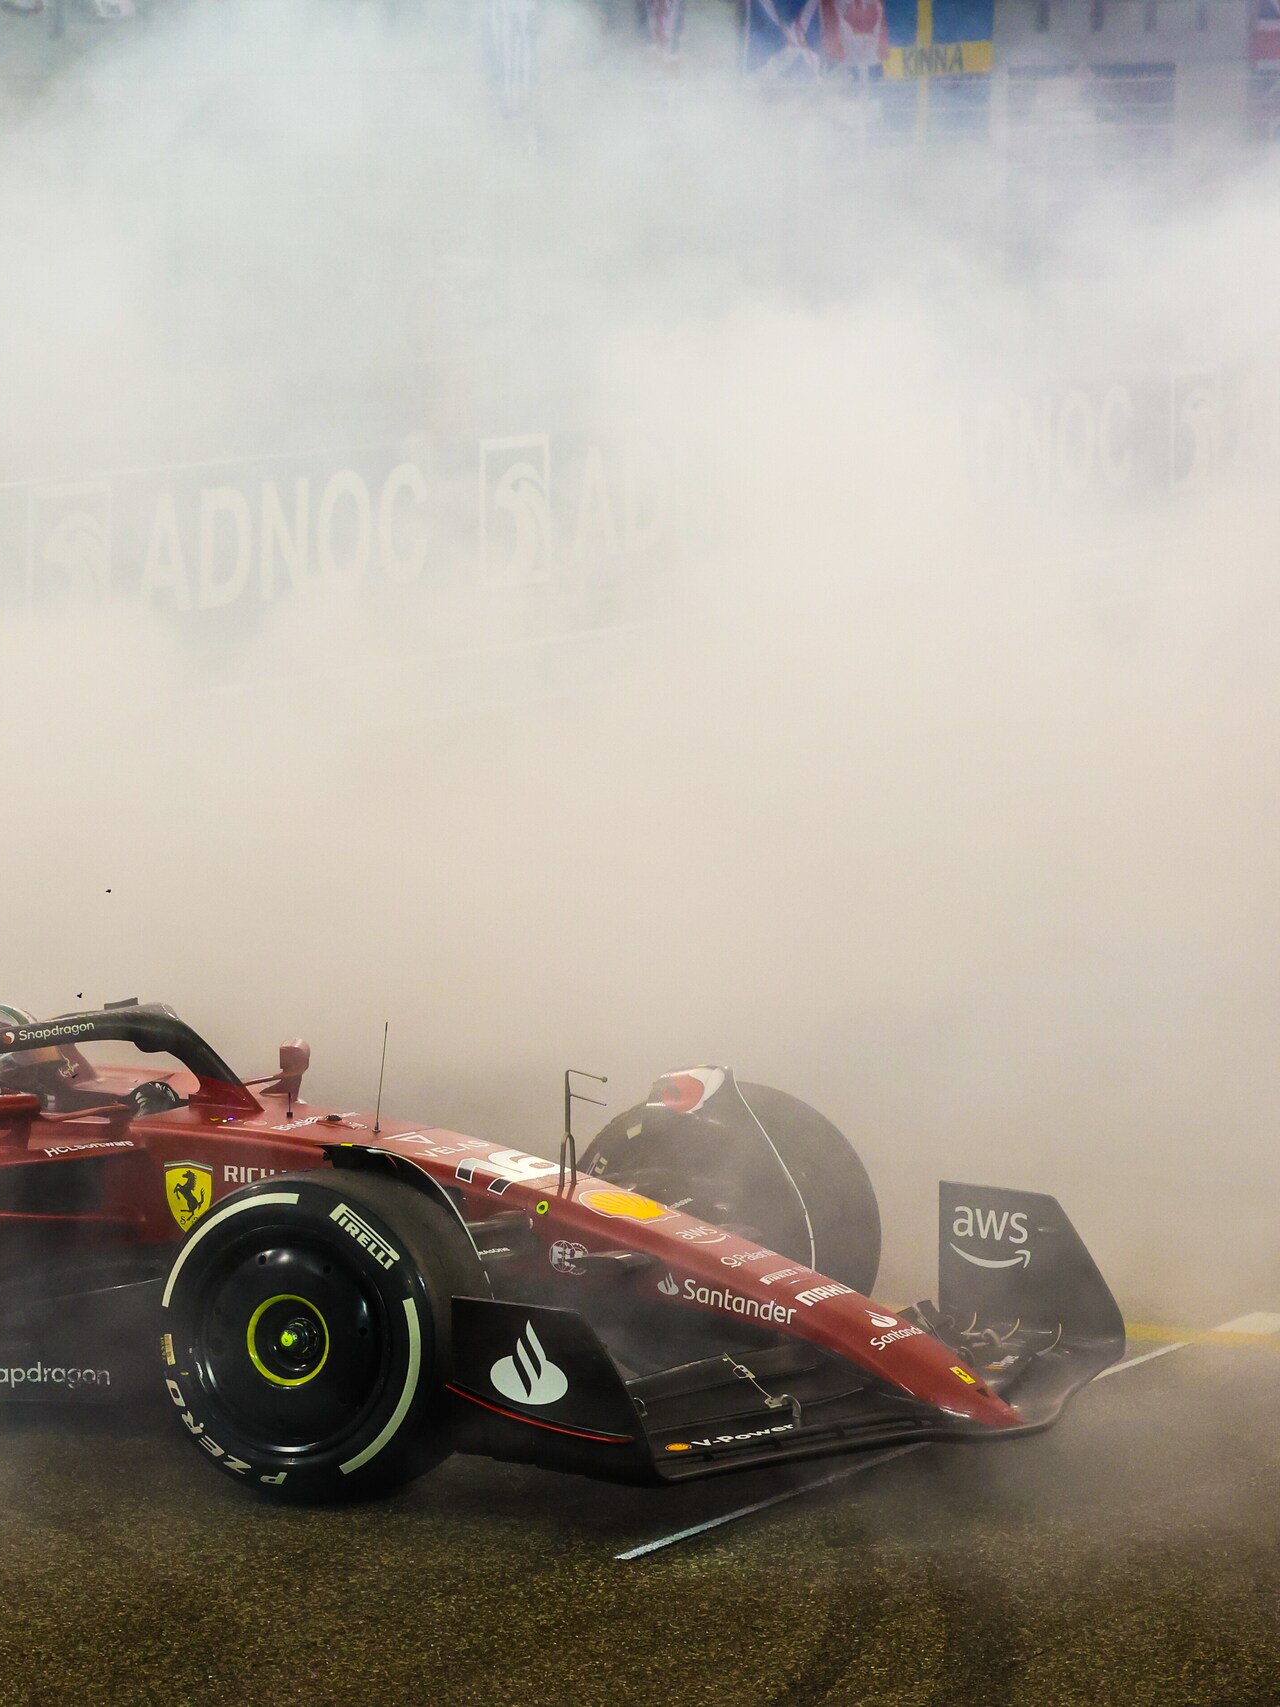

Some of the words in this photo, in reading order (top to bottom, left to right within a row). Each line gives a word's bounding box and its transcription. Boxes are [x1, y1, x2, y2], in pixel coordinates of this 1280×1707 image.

[902, 44, 964, 78] KINNA
[140, 462, 428, 612] ADNOC
[19, 1021, 95, 1041] Snapdragon
[415, 1140, 490, 1159] VELAS
[223, 1165, 287, 1183] RICH
[455, 1149, 571, 1196] 16
[328, 1203, 400, 1271] PIRELLI
[675, 1225, 718, 1241] aws
[952, 1205, 1028, 1245] aws
[682, 1279, 797, 1325] Santander
[794, 1283, 856, 1307] MAHL
[691, 1423, 794, 1447] V-Power
